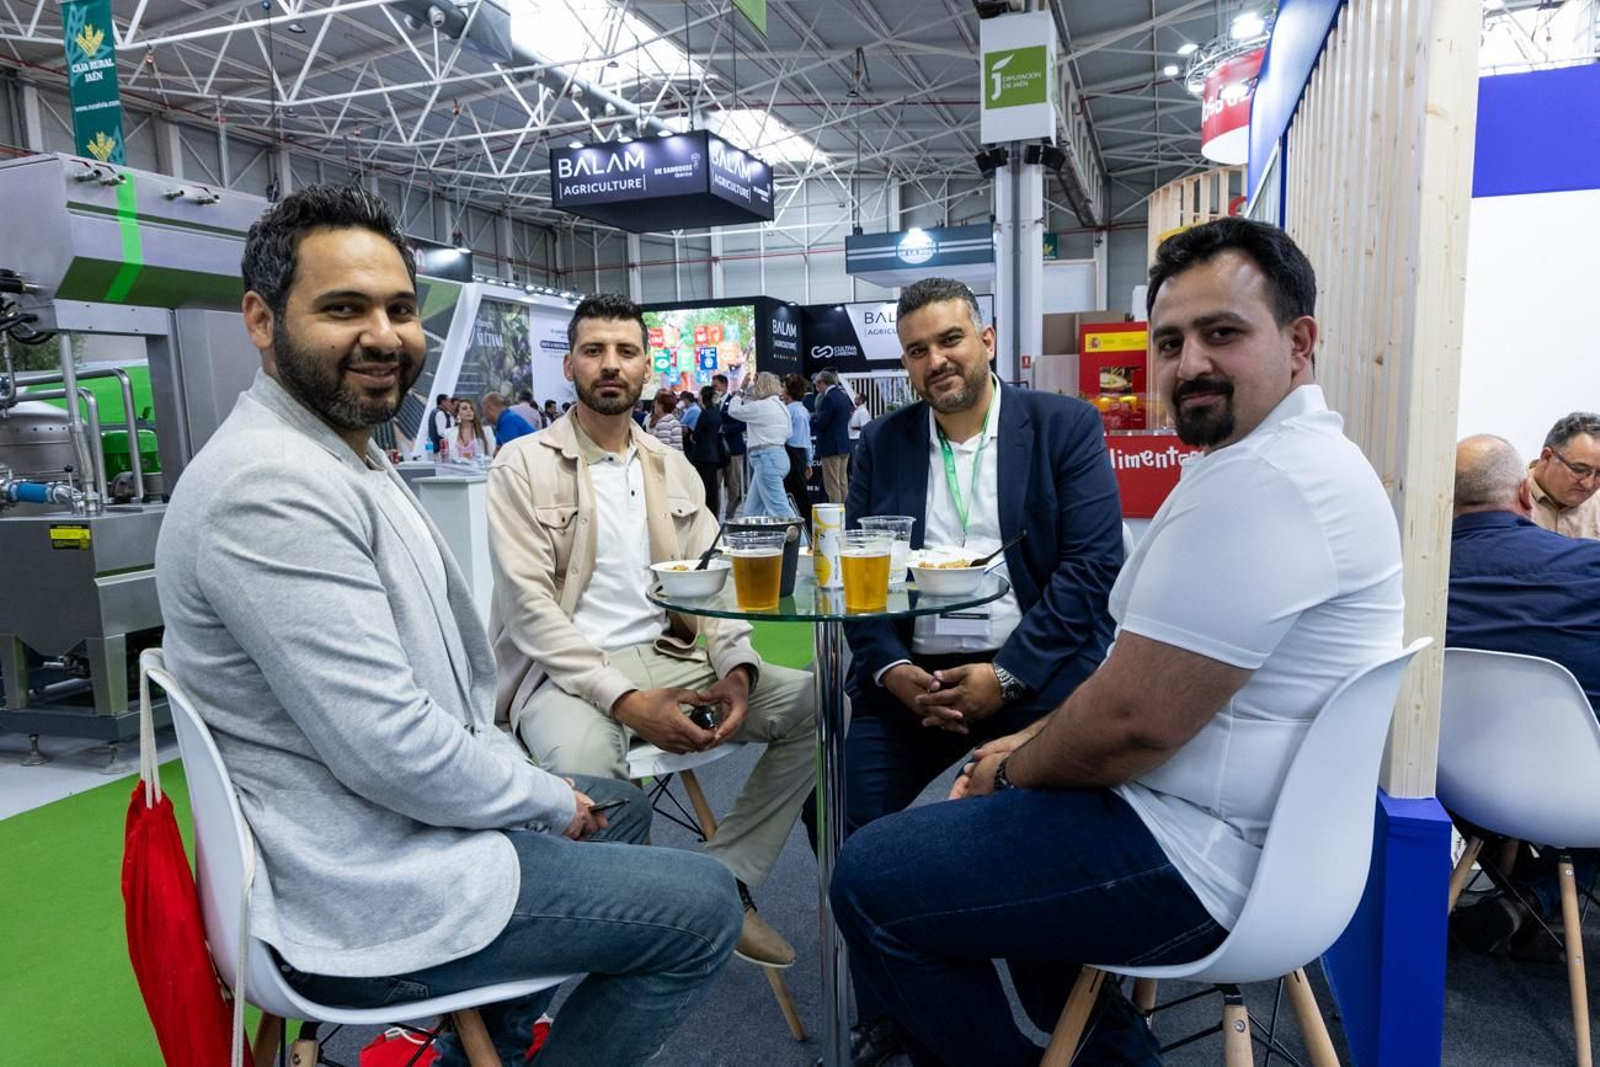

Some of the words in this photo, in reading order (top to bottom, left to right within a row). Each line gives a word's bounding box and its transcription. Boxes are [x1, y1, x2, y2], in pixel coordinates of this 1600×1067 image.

[71, 62, 90, 73] CAJA
[89, 58, 115, 70] RURAL
[1003, 71, 1041, 81] DIPUTACIÓN
[558, 149, 645, 178] BALAM
[711, 144, 751, 183] BALAM
[563, 178, 642, 196] AGRICULTURE
[714, 173, 750, 199] AGRICULTURE
[864, 312, 897, 324] BAL
[772, 319, 797, 338] BALAM
